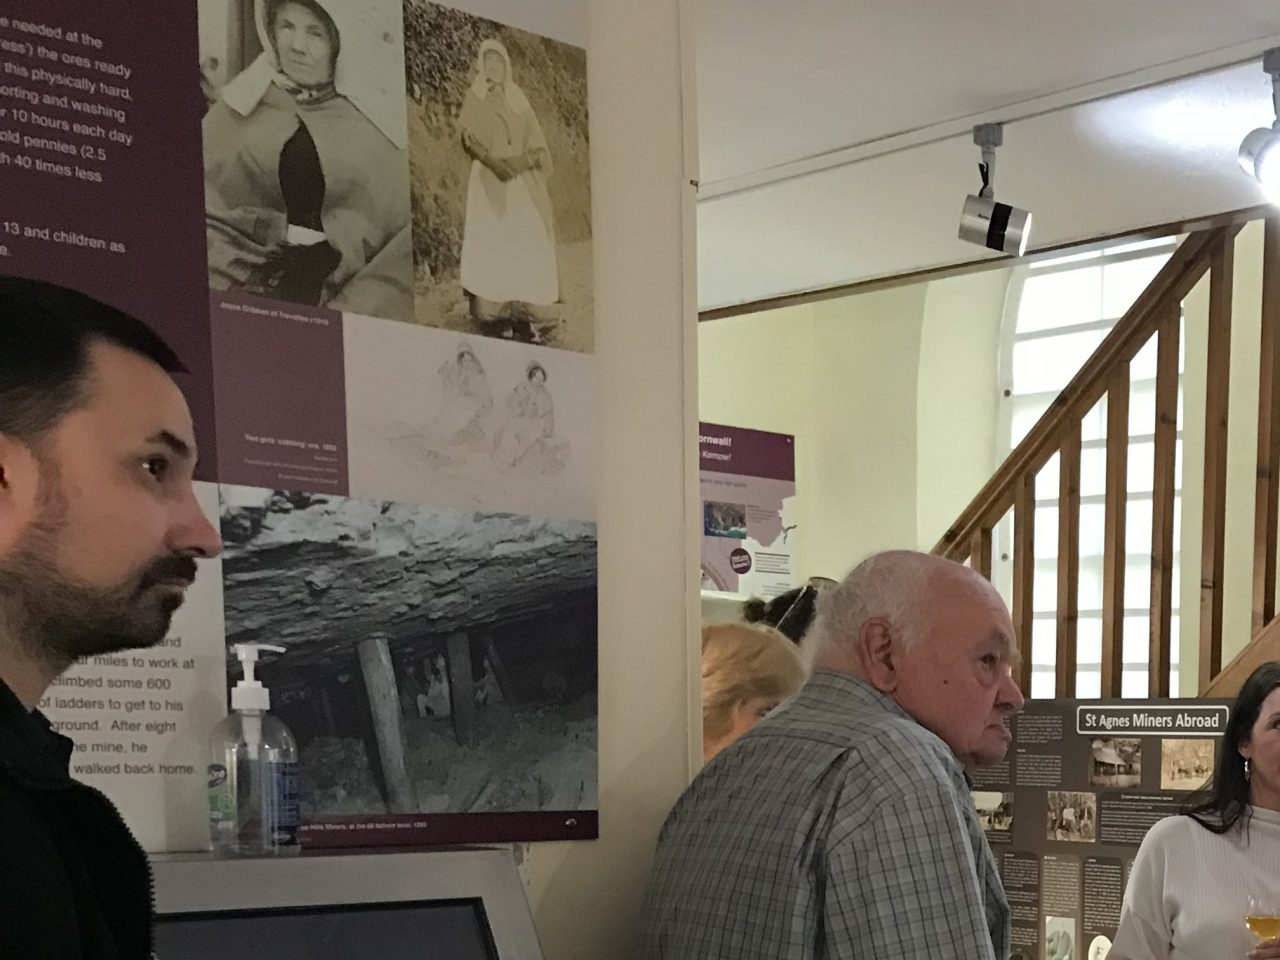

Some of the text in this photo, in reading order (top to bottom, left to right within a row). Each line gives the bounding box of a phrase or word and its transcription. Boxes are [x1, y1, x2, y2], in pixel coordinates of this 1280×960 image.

[12, 20, 62, 39] needed
[65, 31, 79, 43] at
[81, 33, 103, 48] the
[38, 46, 58, 60] the
[62, 53, 91, 68] ores
[95, 61, 131, 79] ready
[4, 62, 29, 77] this
[32, 69, 96, 94] physically
[0, 85, 126, 123] orting and washing
[12, 109, 28, 122] 10
[32, 112, 70, 131] hours
[73, 123, 106, 138] each
[109, 129, 133, 146] day
[24, 136, 78, 155] pennies
[80, 145, 107, 161] (2.5
[14, 155, 32, 168] 40
[35, 159, 72, 176] times
[75, 166, 102, 182] less
[3, 221, 126, 253] 13 and children as
[699, 435, 732, 447] ornwall!
[94, 655, 128, 668] miles
[132, 657, 145, 668] to
[149, 658, 179, 669] work
[182, 659, 195, 670] at
[107, 678, 143, 689] some
[146, 678, 172, 690] 600
[38, 697, 184, 713] of ladders to get to his
[51, 719, 177, 735] ground. After eight
[1085, 712, 1219, 730] St Agnes Miners Abroad
[92, 742, 128, 755] mine,
[131, 741, 148, 753] he
[73, 761, 120, 774] walked
[124, 761, 155, 774] back
